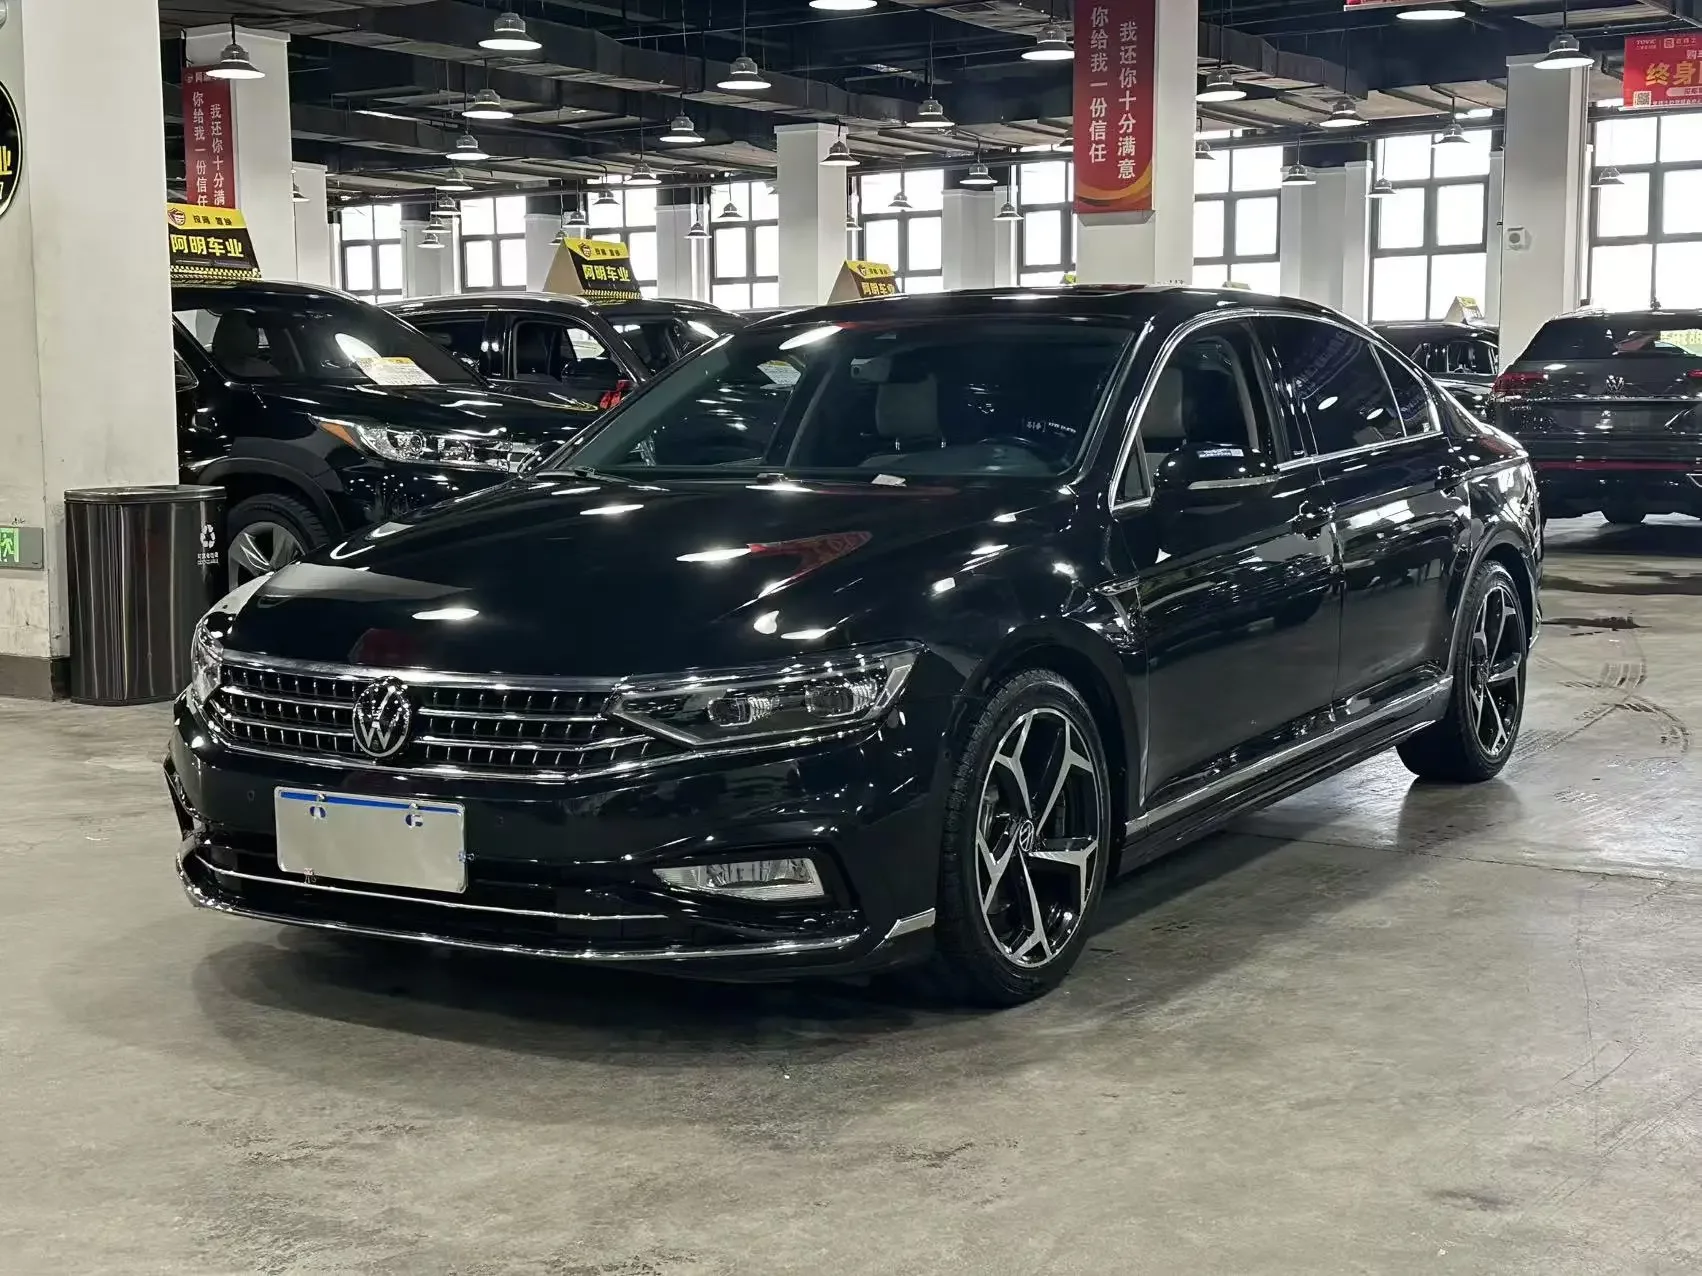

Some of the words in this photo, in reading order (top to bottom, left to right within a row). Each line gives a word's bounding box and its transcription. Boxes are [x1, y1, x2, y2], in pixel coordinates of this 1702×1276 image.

[1088, 6, 1109, 164] 你给我一份信任
[1117, 21, 1138, 180] 我还你十分满意
[1645, 60, 1702, 86] 终身
[192, 91, 208, 207] 你给我一份信任
[169, 233, 245, 258] 阿明车业
[581, 264, 631, 282] 阿明车业
